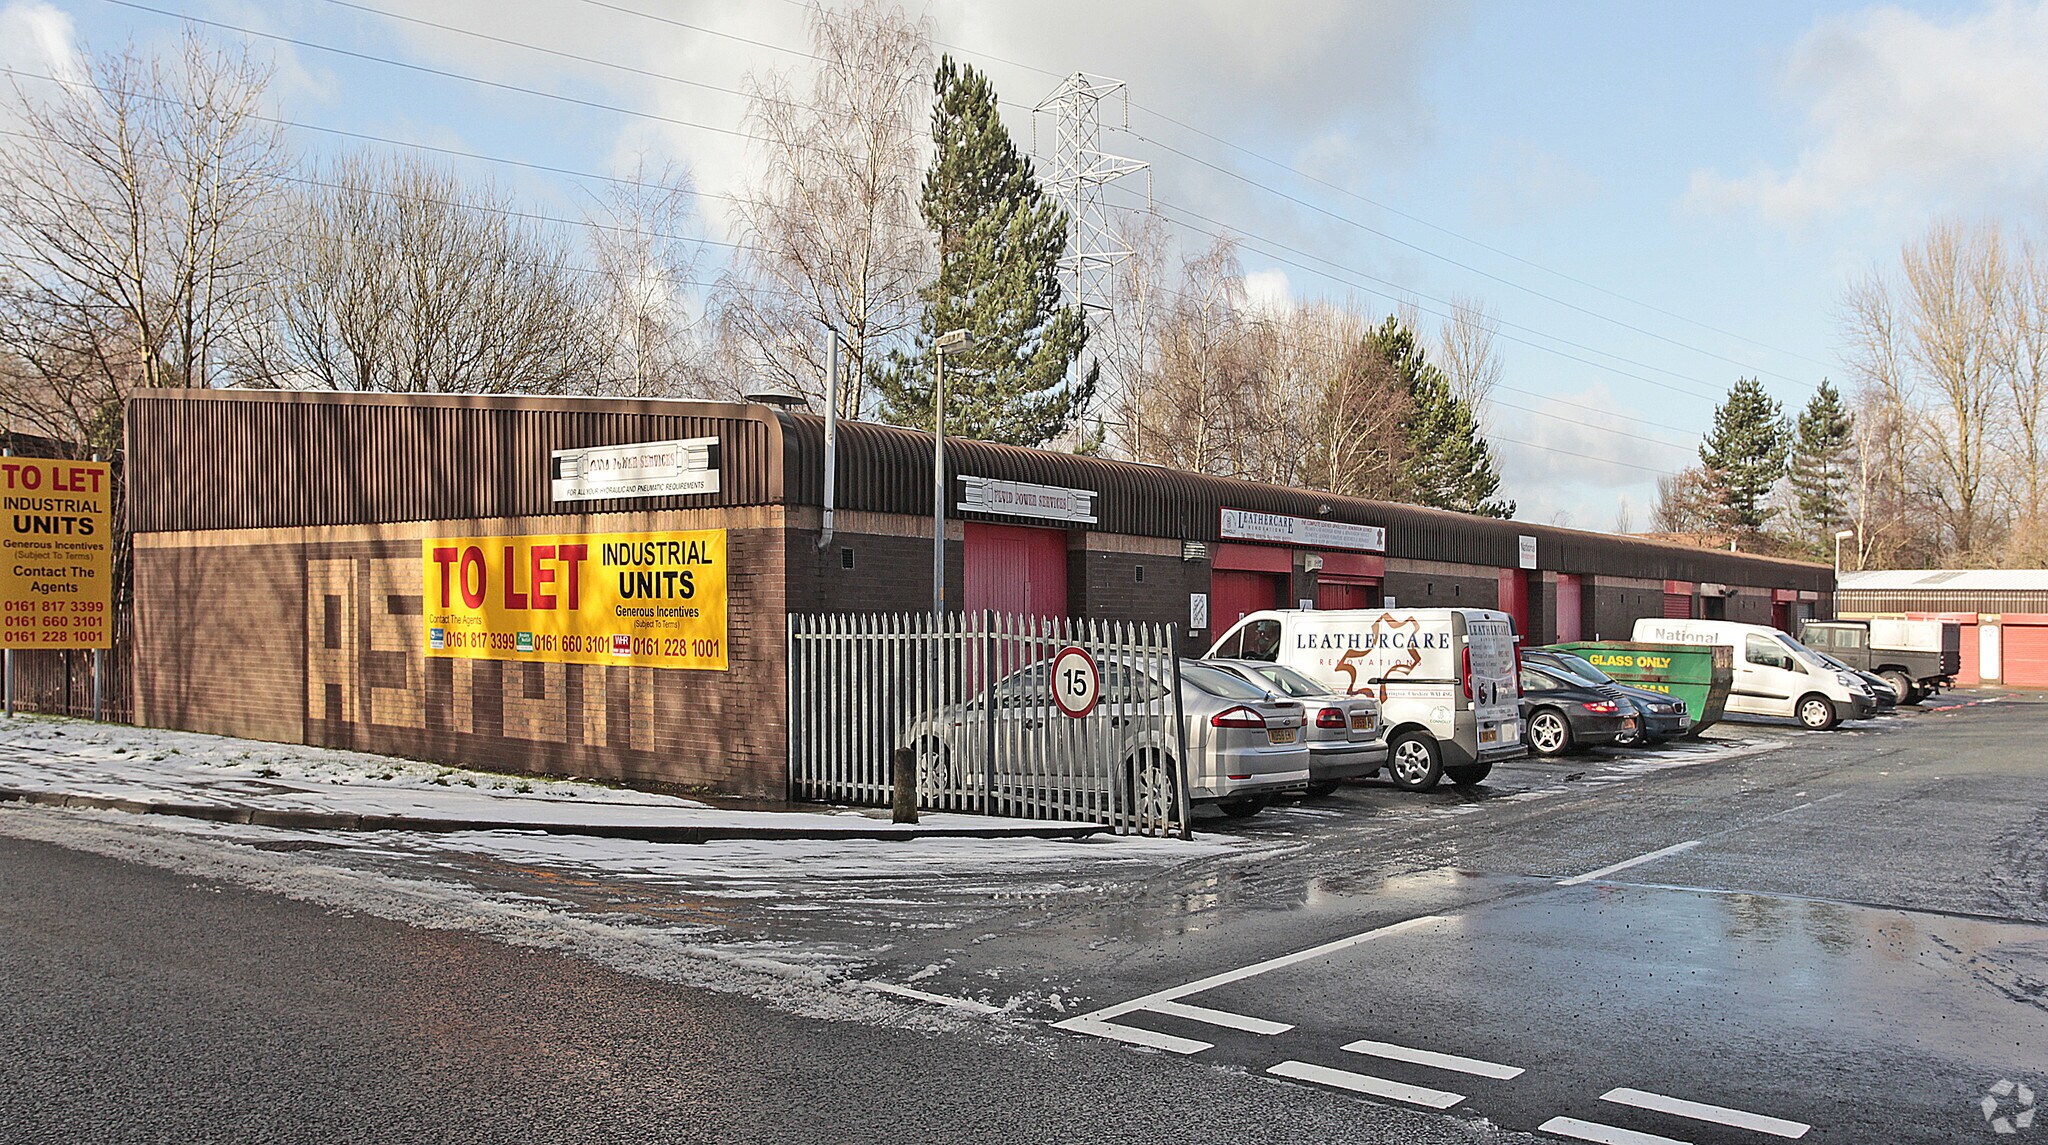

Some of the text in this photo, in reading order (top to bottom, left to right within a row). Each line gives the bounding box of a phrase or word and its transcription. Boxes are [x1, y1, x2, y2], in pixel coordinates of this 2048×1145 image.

[2, 464, 104, 493] TO LET
[586, 487, 598, 495] YOUR
[600, 486, 626, 494] HYDRAULIC
[637, 483, 664, 492] PNEUMATIC
[665, 481, 705, 491] REQUIREMENTS
[4, 496, 103, 514] INDUSTRIAL
[1015, 492, 1037, 507] POWER
[1039, 494, 1067, 510] SERVICES
[14, 514, 94, 535] UNITS
[1238, 511, 1294, 534] LEATHERCARE
[3, 539, 104, 551] Generous Incentives
[603, 540, 713, 566] INDUSTRIAL
[14, 550, 94, 562] (Subject To Terms)
[13, 565, 95, 578] Contact The
[433, 545, 487, 609] TO
[504, 543, 588, 610] LET
[31, 581, 78, 595] Agents
[620, 570, 695, 599] UNITS
[4, 600, 104, 612] 0161 817 3399
[616, 604, 699, 618] Generous Incentives
[5, 616, 102, 627] 0161 660 3101
[429, 614, 482, 626] Contact The Agents
[634, 620, 680, 630] (Subject To Terms)
[4, 630, 102, 642] 0161 228 1001
[446, 632, 467, 648] 0161
[470, 632, 488, 648] 817
[490, 632, 515, 650] 3399
[534, 634, 557, 652] 0161
[562, 635, 582, 652] 660
[585, 636, 610, 653] 3101
[1297, 633, 1450, 649] LEATHERCARE
[1656, 628, 1718, 644] National
[633, 637, 720, 658] 0161 228 1001
[1590, 654, 1672, 668] GLASS ONLY
[1063, 668, 1087, 696] 15
